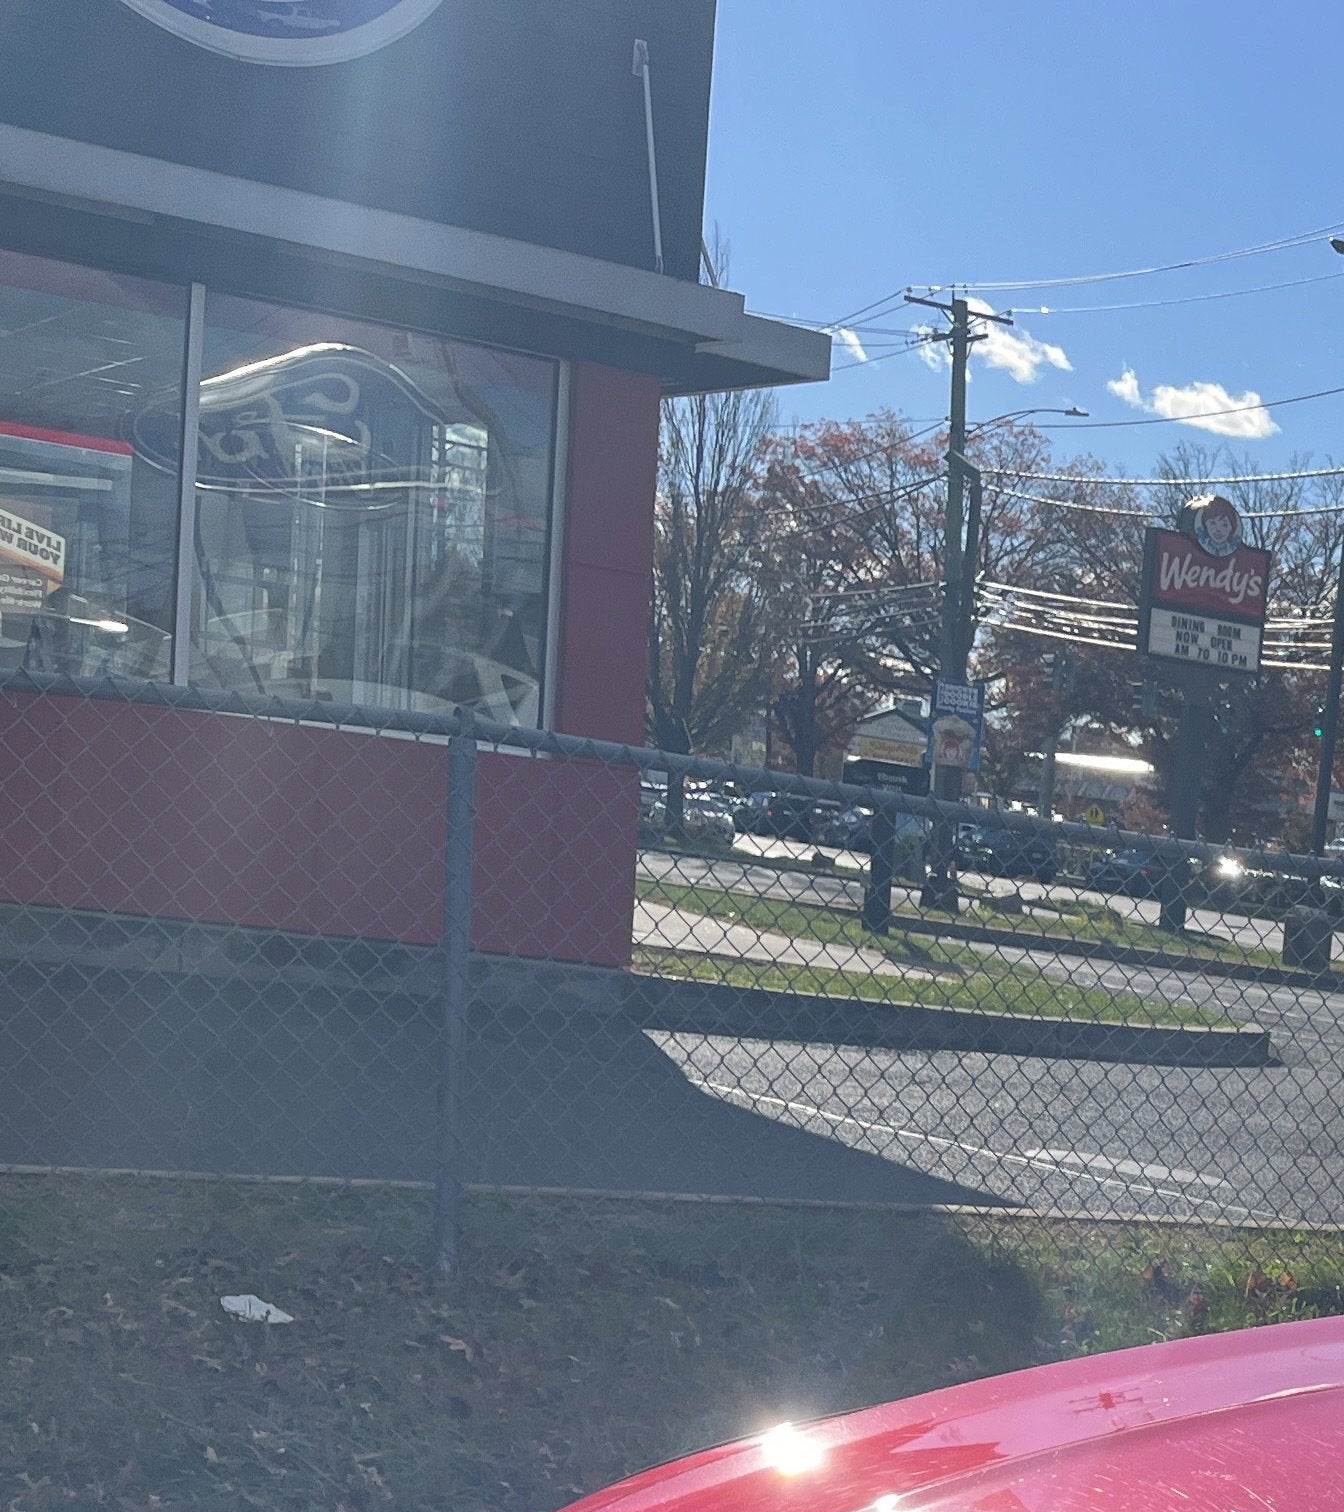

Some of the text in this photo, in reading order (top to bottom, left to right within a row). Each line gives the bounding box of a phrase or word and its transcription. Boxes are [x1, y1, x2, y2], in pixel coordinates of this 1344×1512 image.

[1160, 551, 1262, 604] Wendy's
[1171, 615, 1242, 640] DINING ROOM
[1176, 630, 1233, 651] NOW OPEN
[1174, 645, 1247, 666] AM TO 10 PM
